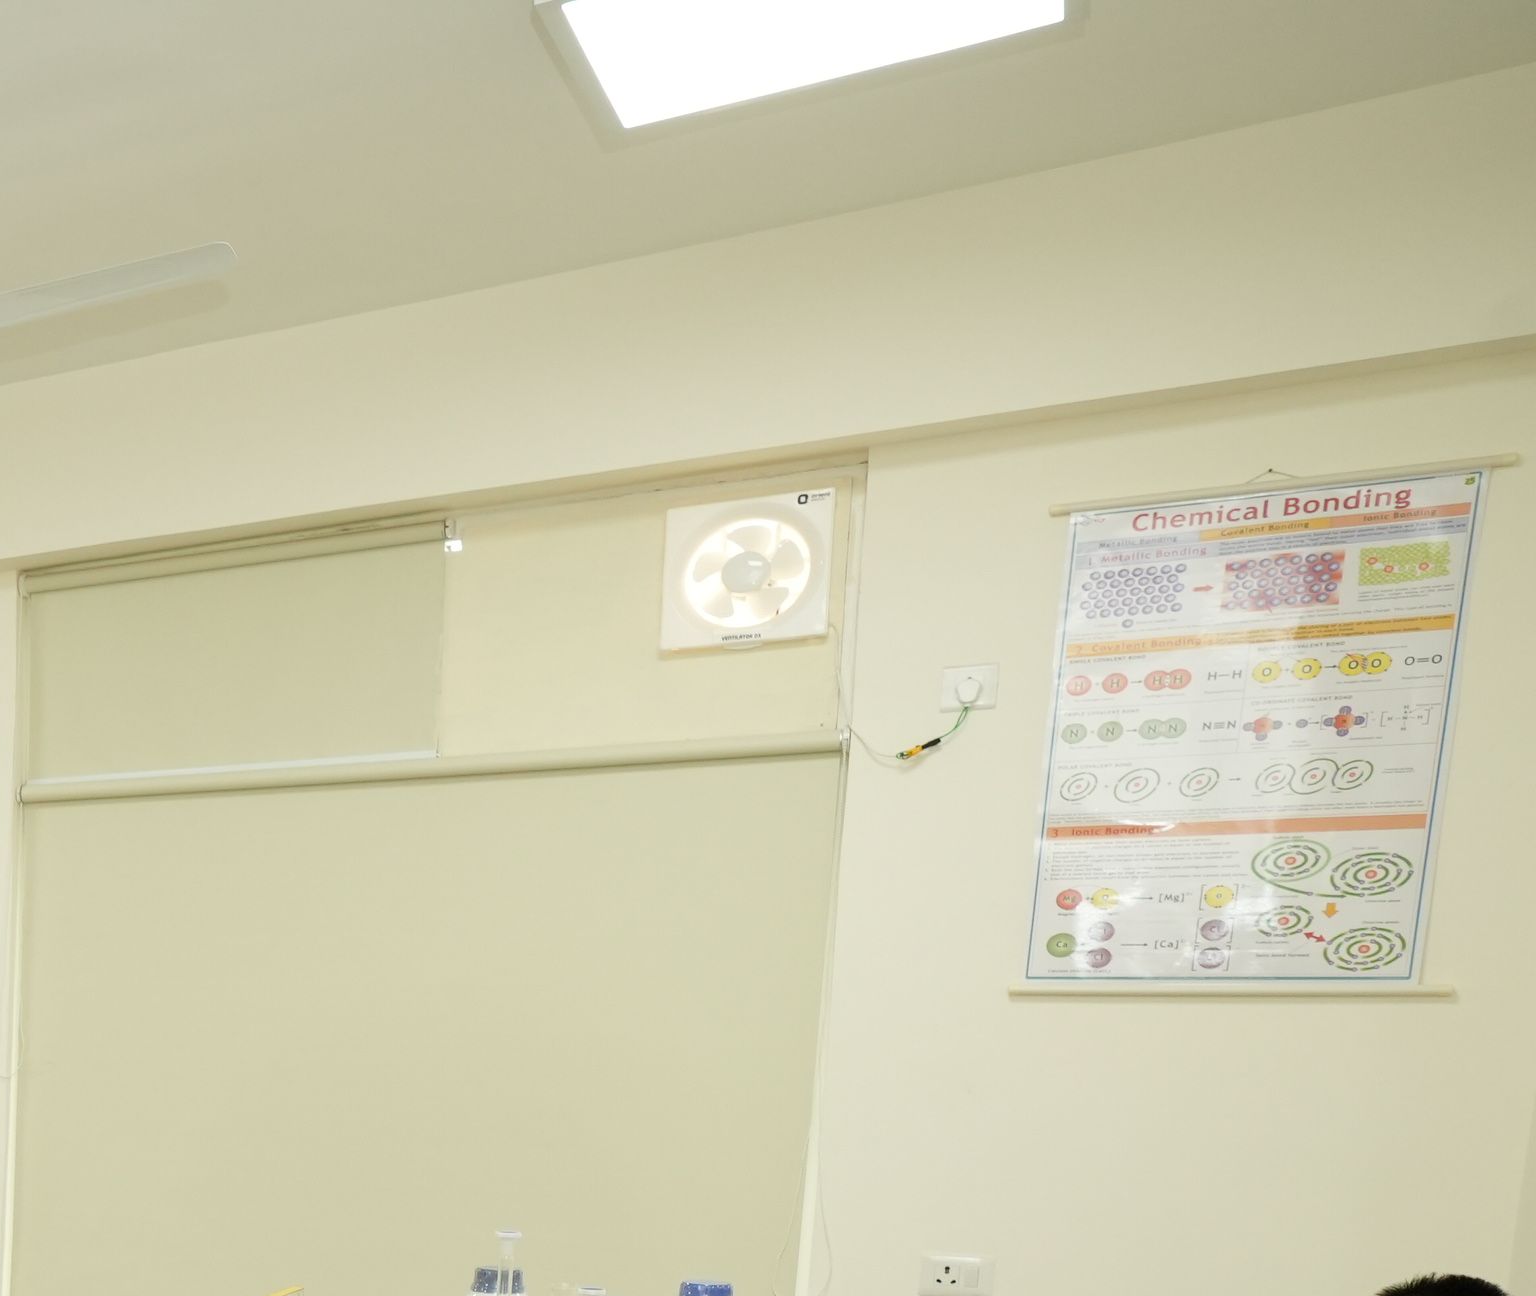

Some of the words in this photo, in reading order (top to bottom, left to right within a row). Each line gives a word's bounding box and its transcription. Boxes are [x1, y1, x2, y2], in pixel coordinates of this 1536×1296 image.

[1132, 500, 1270, 532] Chemical
[1283, 488, 1412, 516] Bonding
[1363, 513, 1390, 522] Ionic
[1393, 509, 1437, 520] Bonding
[1220, 526, 1265, 537] Covalent
[1268, 522, 1309, 531] Bonding
[1139, 536, 1177, 546] Bonding
[1101, 551, 1151, 563] Metallic
[1156, 547, 1207, 560] Bonding
[1092, 641, 1145, 652] Covalent
[1151, 637, 1201, 649] Bonding
[1052, 829, 1058, 837] 3
[1072, 828, 1100, 836] Ionic
